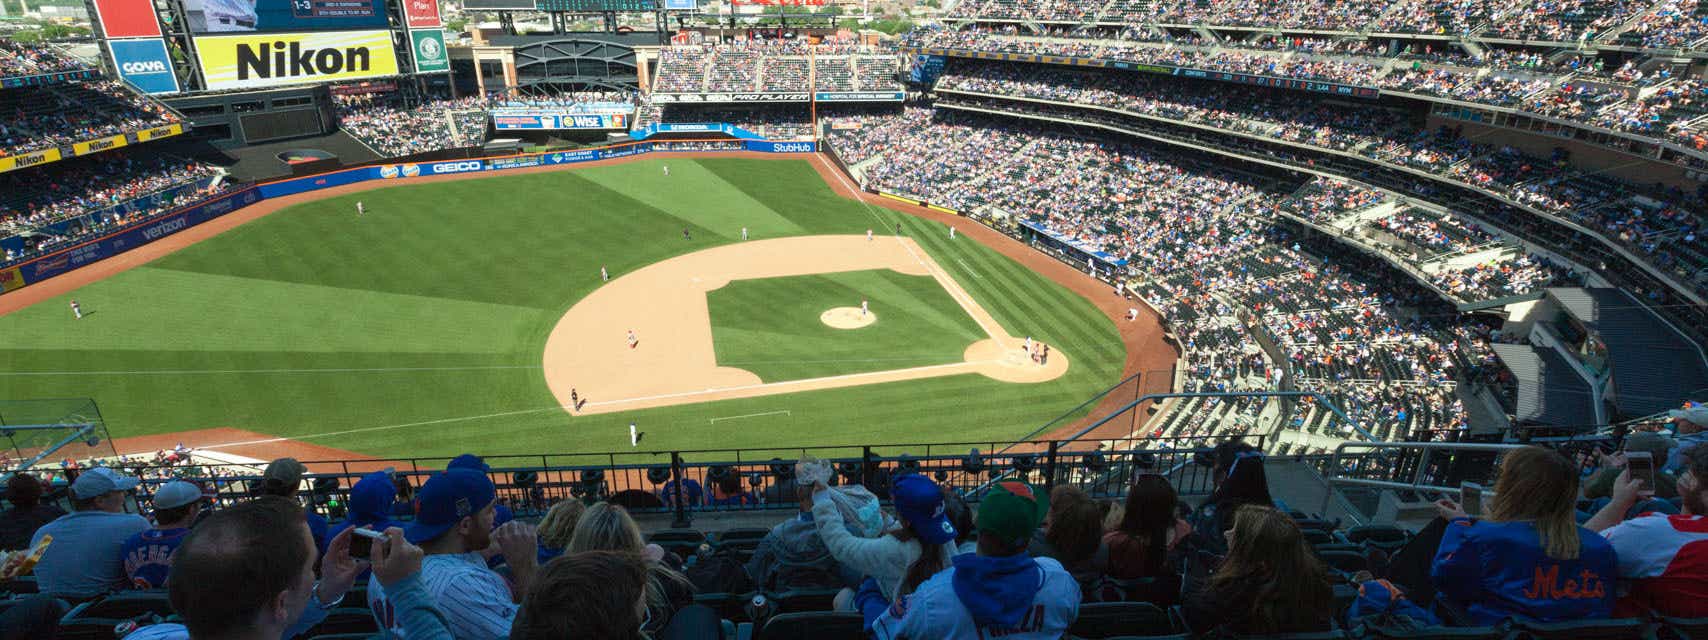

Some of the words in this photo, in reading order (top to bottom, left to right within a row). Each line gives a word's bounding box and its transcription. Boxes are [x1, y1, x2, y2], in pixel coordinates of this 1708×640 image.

[236, 41, 370, 80] Nikon
[123, 61, 166, 73] GOYA
[575, 116, 600, 127] WISE
[150, 128, 172, 138] Nikon
[88, 138, 114, 151] Nikon
[773, 143, 811, 152] StubHub
[15, 153, 45, 167] Nikon
[433, 161, 481, 173] GEICO
[142, 217, 186, 240] verizon
[1522, 564, 1606, 600] Mets
